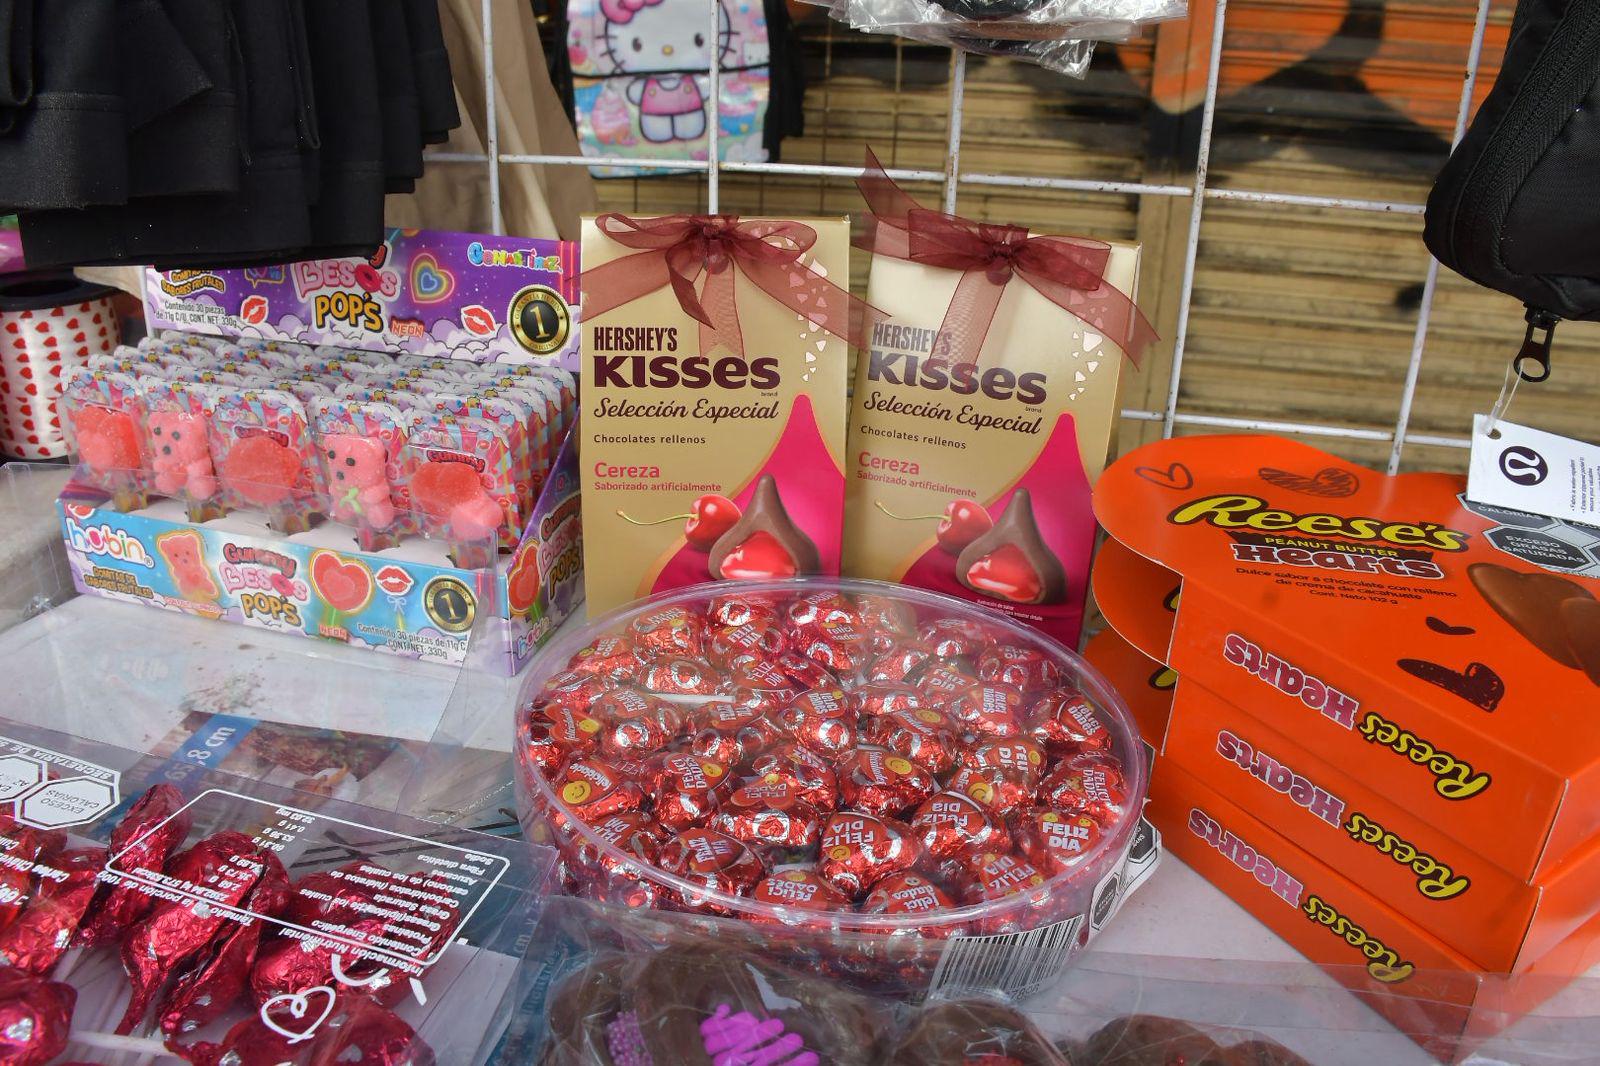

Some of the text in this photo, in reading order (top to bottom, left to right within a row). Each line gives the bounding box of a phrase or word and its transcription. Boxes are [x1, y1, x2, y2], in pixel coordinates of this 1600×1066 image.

[294, 260, 398, 299] BESOS
[156, 311, 164, 319] de
[165, 301, 195, 312] Contenido
[204, 305, 225, 315] piezas
[315, 290, 383, 332] POP'S
[392, 319, 424, 337] NEON
[530, 306, 550, 338] 1
[594, 326, 678, 352] HERSHEY'S
[593, 397, 780, 424] Selección Especial
[863, 391, 1042, 434] Selección Especial
[593, 434, 706, 444] Chocolates rellenos
[860, 425, 967, 450] Chocolates rellenos
[594, 462, 660, 478] Cereza
[858, 451, 920, 476] Cereza
[594, 481, 722, 492] Saborizado artificialmente
[857, 470, 977, 498] Saborizado artificialmente
[1170, 495, 1467, 551] Reese's
[67, 518, 144, 562] hobin
[1265, 537, 1398, 557] PEANUT BUTTER
[1504, 534, 1561, 549] EXCESO
[1510, 541, 1567, 556] GRASAS
[1230, 543, 1445, 580] Hearts
[1502, 545, 1586, 564] SATURADAS
[219, 562, 307, 601] BESOS
[1235, 567, 1271, 577] Dulce
[1275, 572, 1309, 581] sabor
[1323, 577, 1379, 590] chocolate
[1383, 583, 1411, 591] con
[1414, 587, 1457, 598] relleno
[1275, 578, 1292, 586] de
[1294, 581, 1335, 591] crema
[1357, 587, 1424, 600] cacahuate
[1309, 589, 1336, 598] Cont.
[1340, 593, 1366, 601] Neto
[441, 593, 461, 620] 1
[358, 623, 395, 637] Contenido
[396, 630, 407, 640] 30
[409, 634, 433, 645] piezas
[435, 639, 446, 647] de
[428, 647, 448, 659] 330g
[1224, 633, 1492, 800] Reese's Hearts
[204, 725, 236, 751] cm
[10, 743, 30, 754] DE
[999, 747, 1014, 767] DÍ
[39, 797, 84, 814] EXCESO
[275, 807, 291, 816] mg
[1216, 729, 1471, 901] Reese's Hearts
[251, 836, 260, 844] g
[823, 830, 874, 847] FELIZ
[1042, 821, 1089, 840] FELIZ
[229, 854, 238, 862] g
[464, 852, 493, 864] Sodio
[688, 837, 715, 863] FELIZ
[31, 863, 69, 883] Carlos
[97, 869, 120, 885] 100g
[217, 864, 227, 872] g
[459, 863, 485, 874] Fibra
[989, 863, 1036, 890] FELIZ
[124, 879, 137, 890] de
[208, 874, 218, 883] g
[344, 873, 388, 889] (hidratos
[359, 864, 468, 895] carbono) de los cuales
[181, 898, 192, 907] la
[299, 888, 332, 901] cuales
[389, 883, 459, 906] Carbohidratos
[1187, 808, 1416, 984] Reese's Hearts
[372, 893, 450, 919] Grasa Saturada
[367, 933, 422, 956] Contenido
